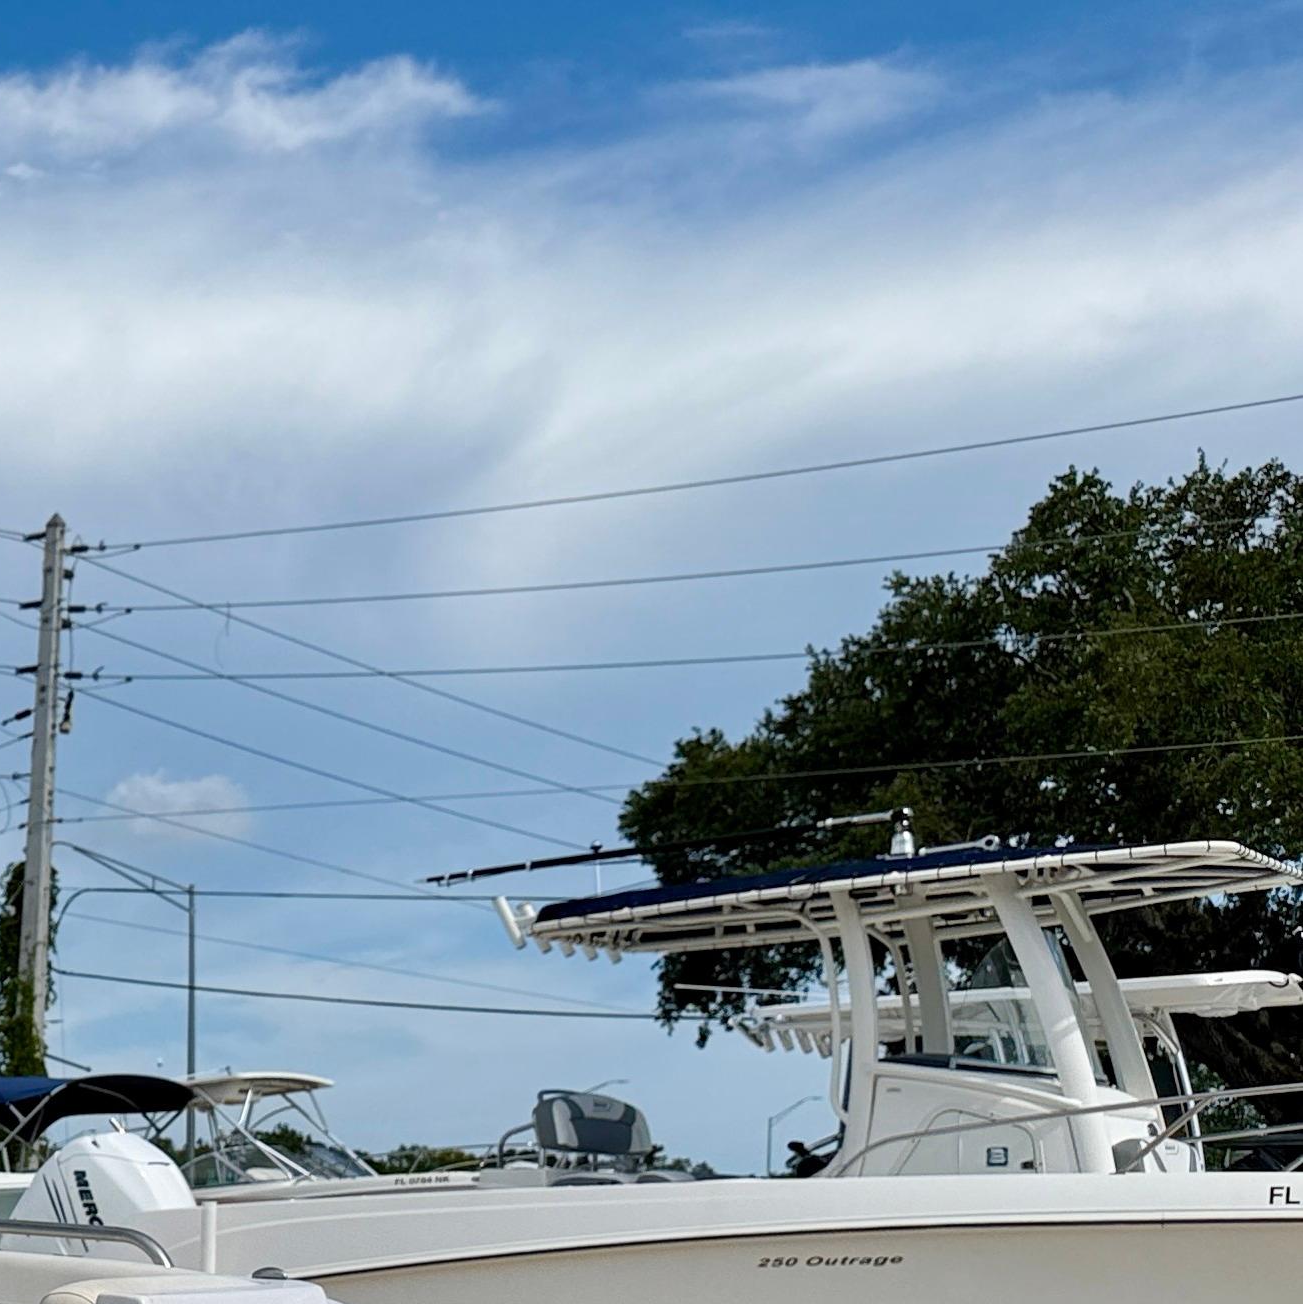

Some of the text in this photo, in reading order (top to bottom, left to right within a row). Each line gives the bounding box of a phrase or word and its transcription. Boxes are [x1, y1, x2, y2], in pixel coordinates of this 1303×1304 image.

[1269, 1186, 1301, 1205] FL
[757, 1256, 904, 1268] 250 Outrage
